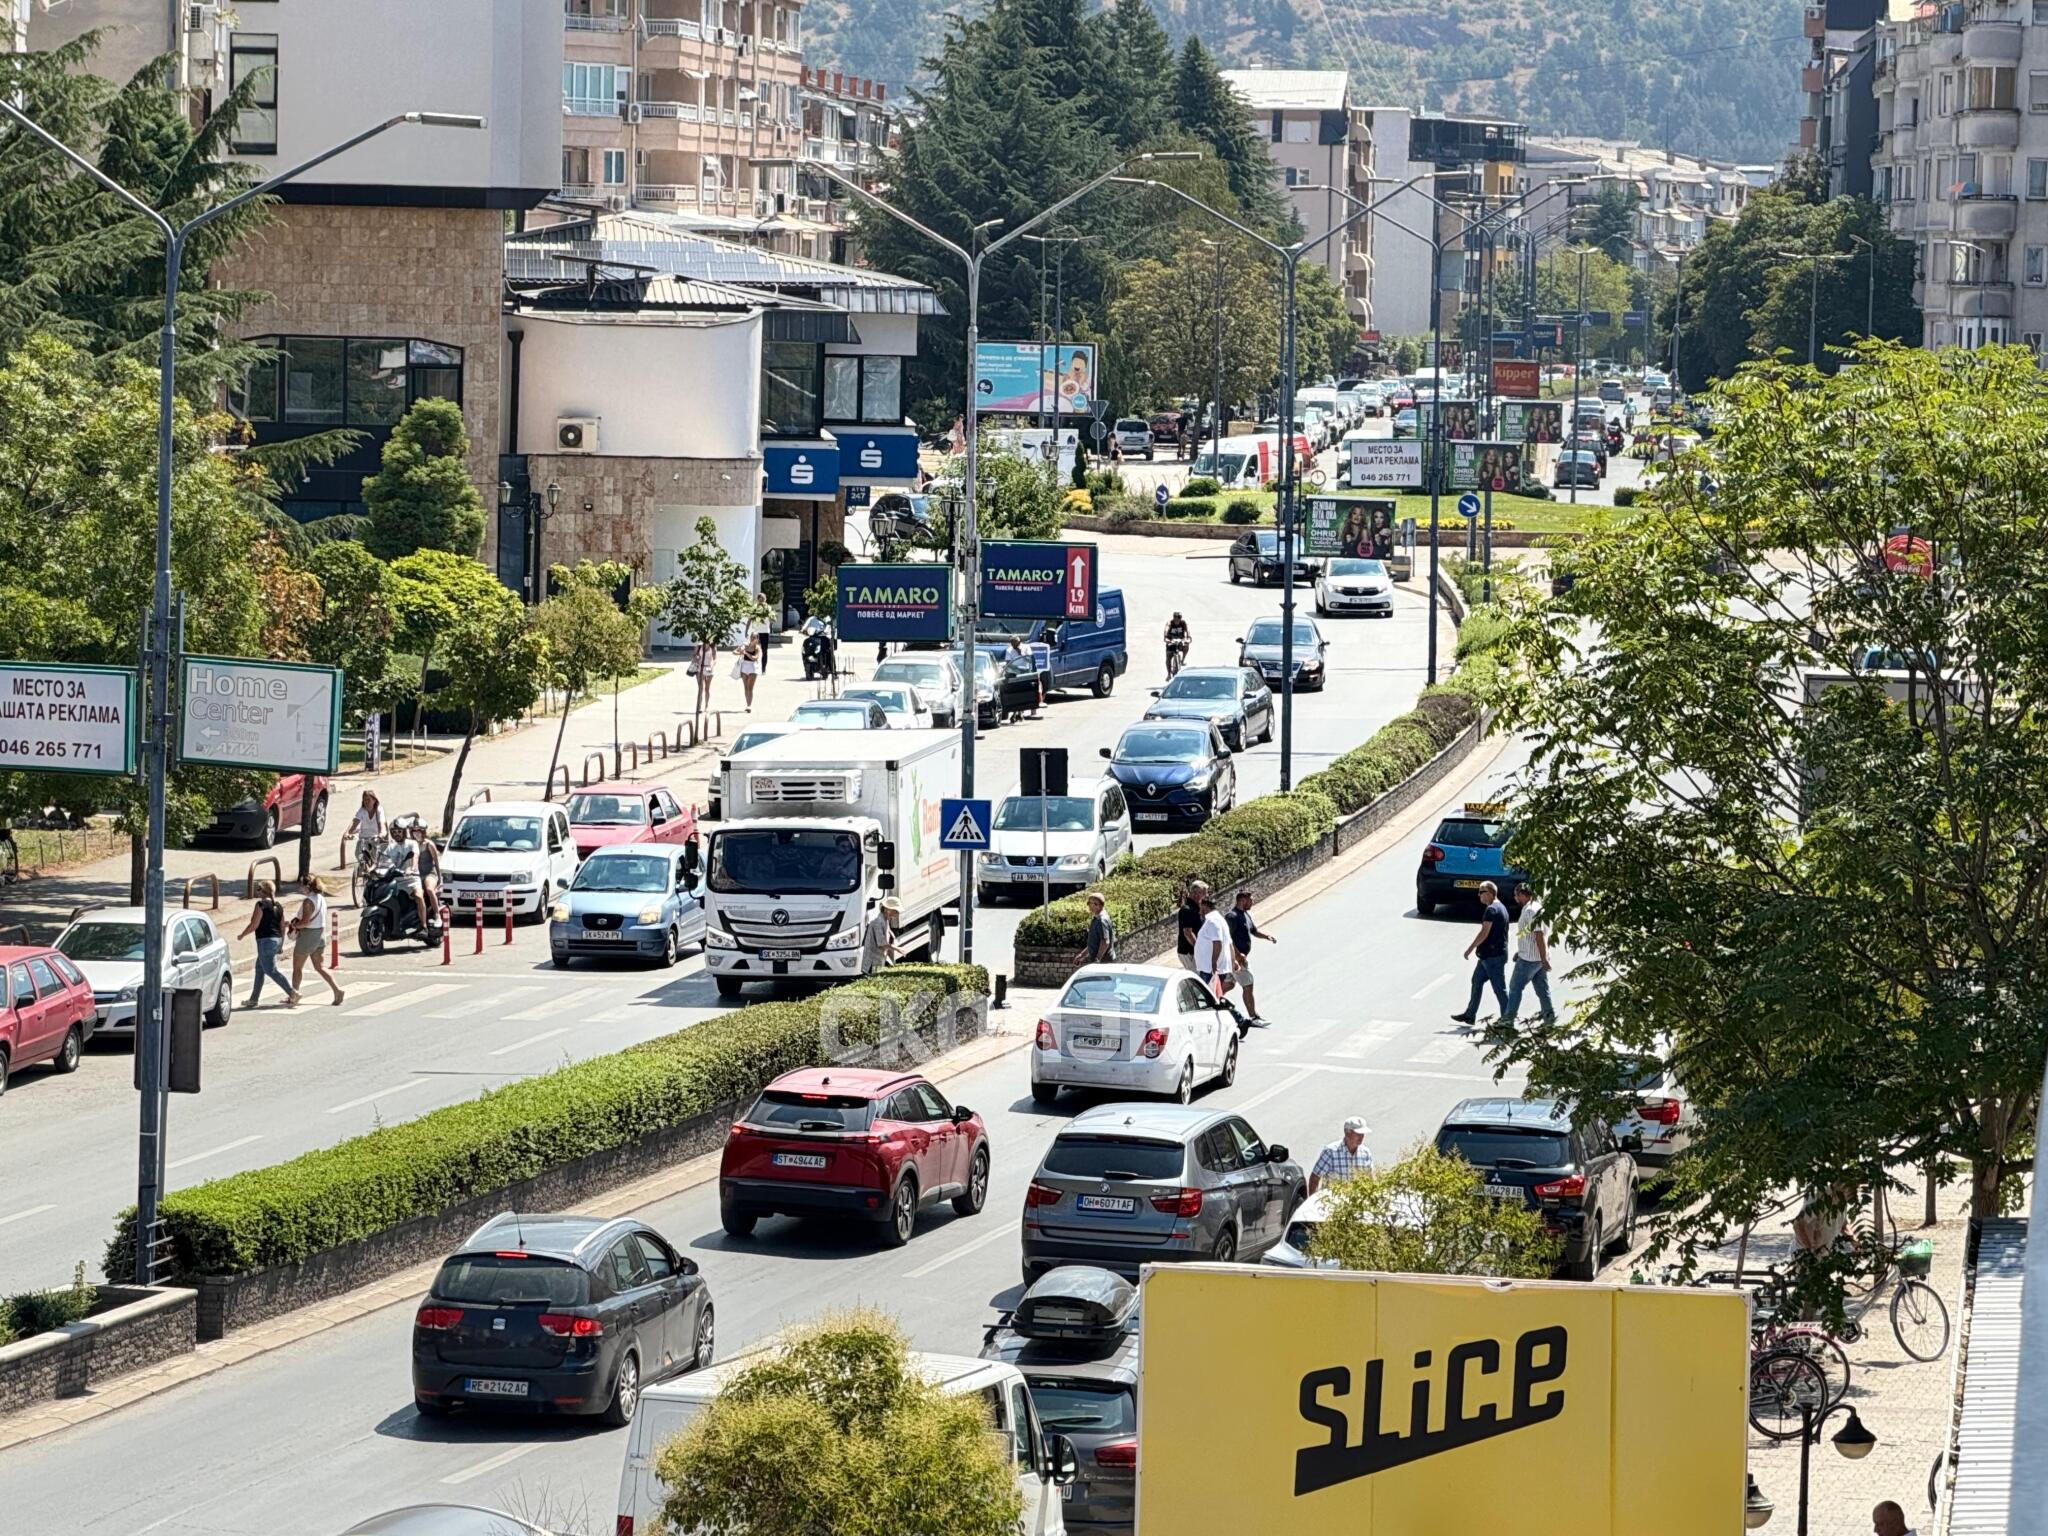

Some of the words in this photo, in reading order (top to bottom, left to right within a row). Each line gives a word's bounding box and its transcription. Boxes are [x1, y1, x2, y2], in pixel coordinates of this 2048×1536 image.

[1494, 365, 1534, 380] kipper
[1368, 446, 1392, 454] МЕСТО
[1393, 446, 1403, 454] ЗА
[1354, 456, 1383, 464] ВАШАТА
[1385, 456, 1419, 464] РЕКЛАМА
[1310, 530, 1336, 538] OHRID
[987, 568, 1054, 582] TAMARO
[1056, 570, 1065, 584] 7
[845, 587, 939, 604] TAMARO
[885, 611, 896, 619] ОД
[897, 611, 925, 619] МАРКЕТ
[1069, 602, 1085, 614] km
[13, 678, 64, 698] МЕСТО
[67, 681, 86, 699] ЗА
[190, 667, 288, 700] Home
[49, 703, 120, 724] РЕКЛАМА
[189, 697, 274, 725] Center
[0, 739, 29, 755] 046
[36, 741, 67, 757] 265
[73, 743, 101, 759] 771
